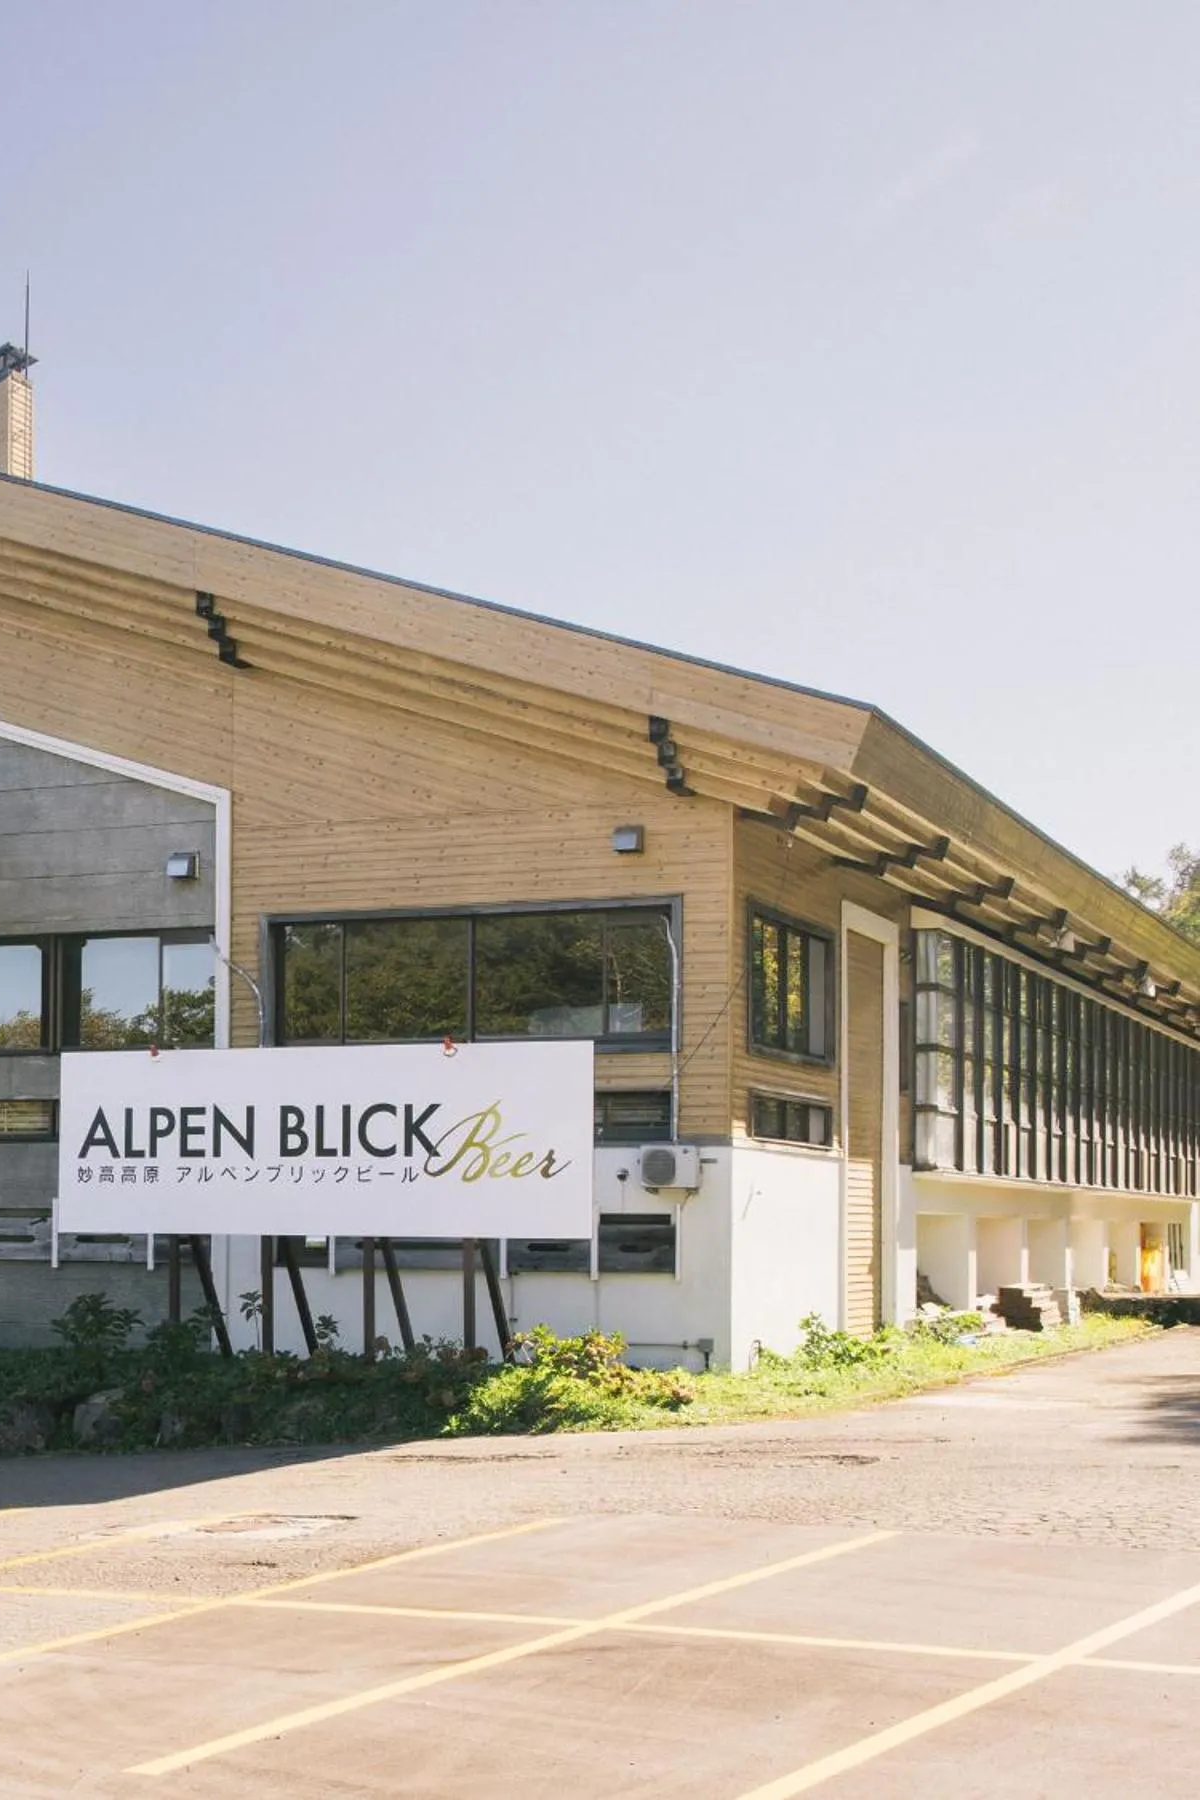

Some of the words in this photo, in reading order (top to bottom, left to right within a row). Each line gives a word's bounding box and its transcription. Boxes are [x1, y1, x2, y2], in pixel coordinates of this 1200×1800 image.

[78, 1104, 255, 1159] ALPEN
[280, 1103, 442, 1158] BLICK
[424, 1099, 574, 1183] Beer
[77, 1165, 161, 1184] 妙高高原
